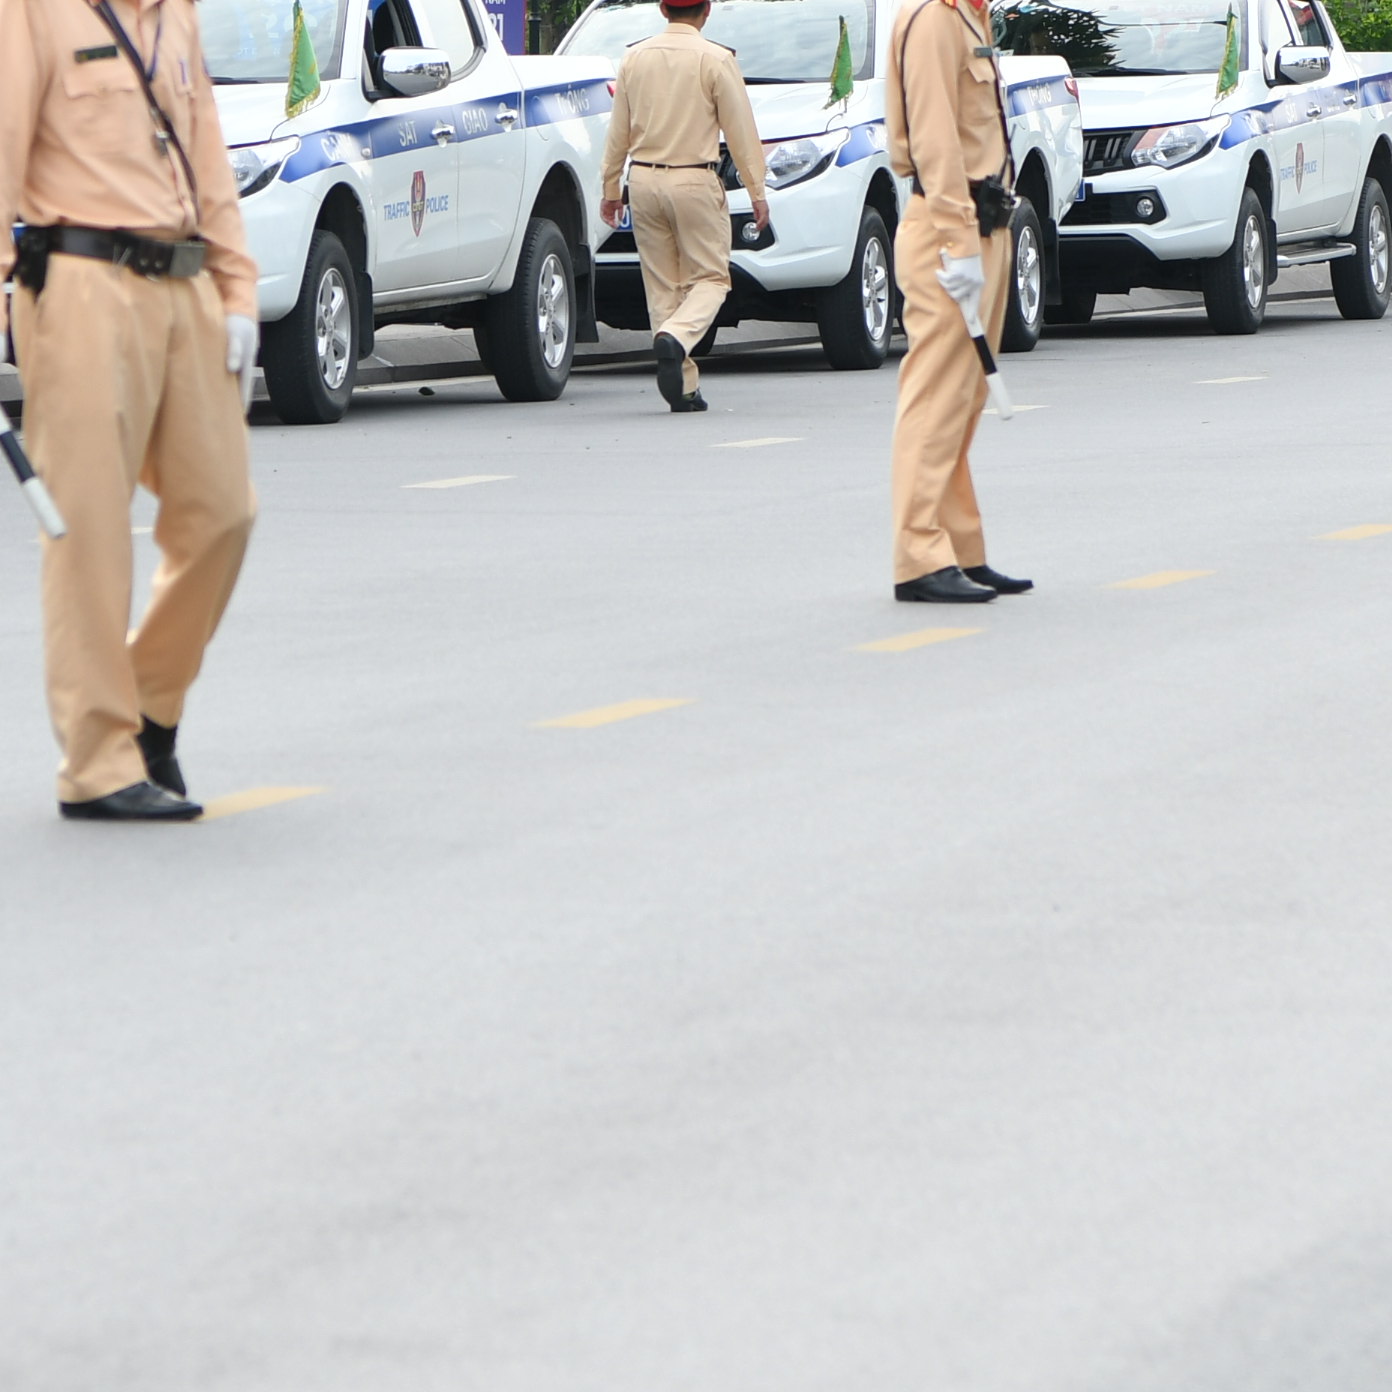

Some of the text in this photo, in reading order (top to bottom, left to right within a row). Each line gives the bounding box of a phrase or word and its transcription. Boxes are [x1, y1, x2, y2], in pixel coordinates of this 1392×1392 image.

[462, 107, 488, 135] GIAO
[383, 200, 410, 221] TRAFFIC
[425, 194, 449, 215] POLICE
